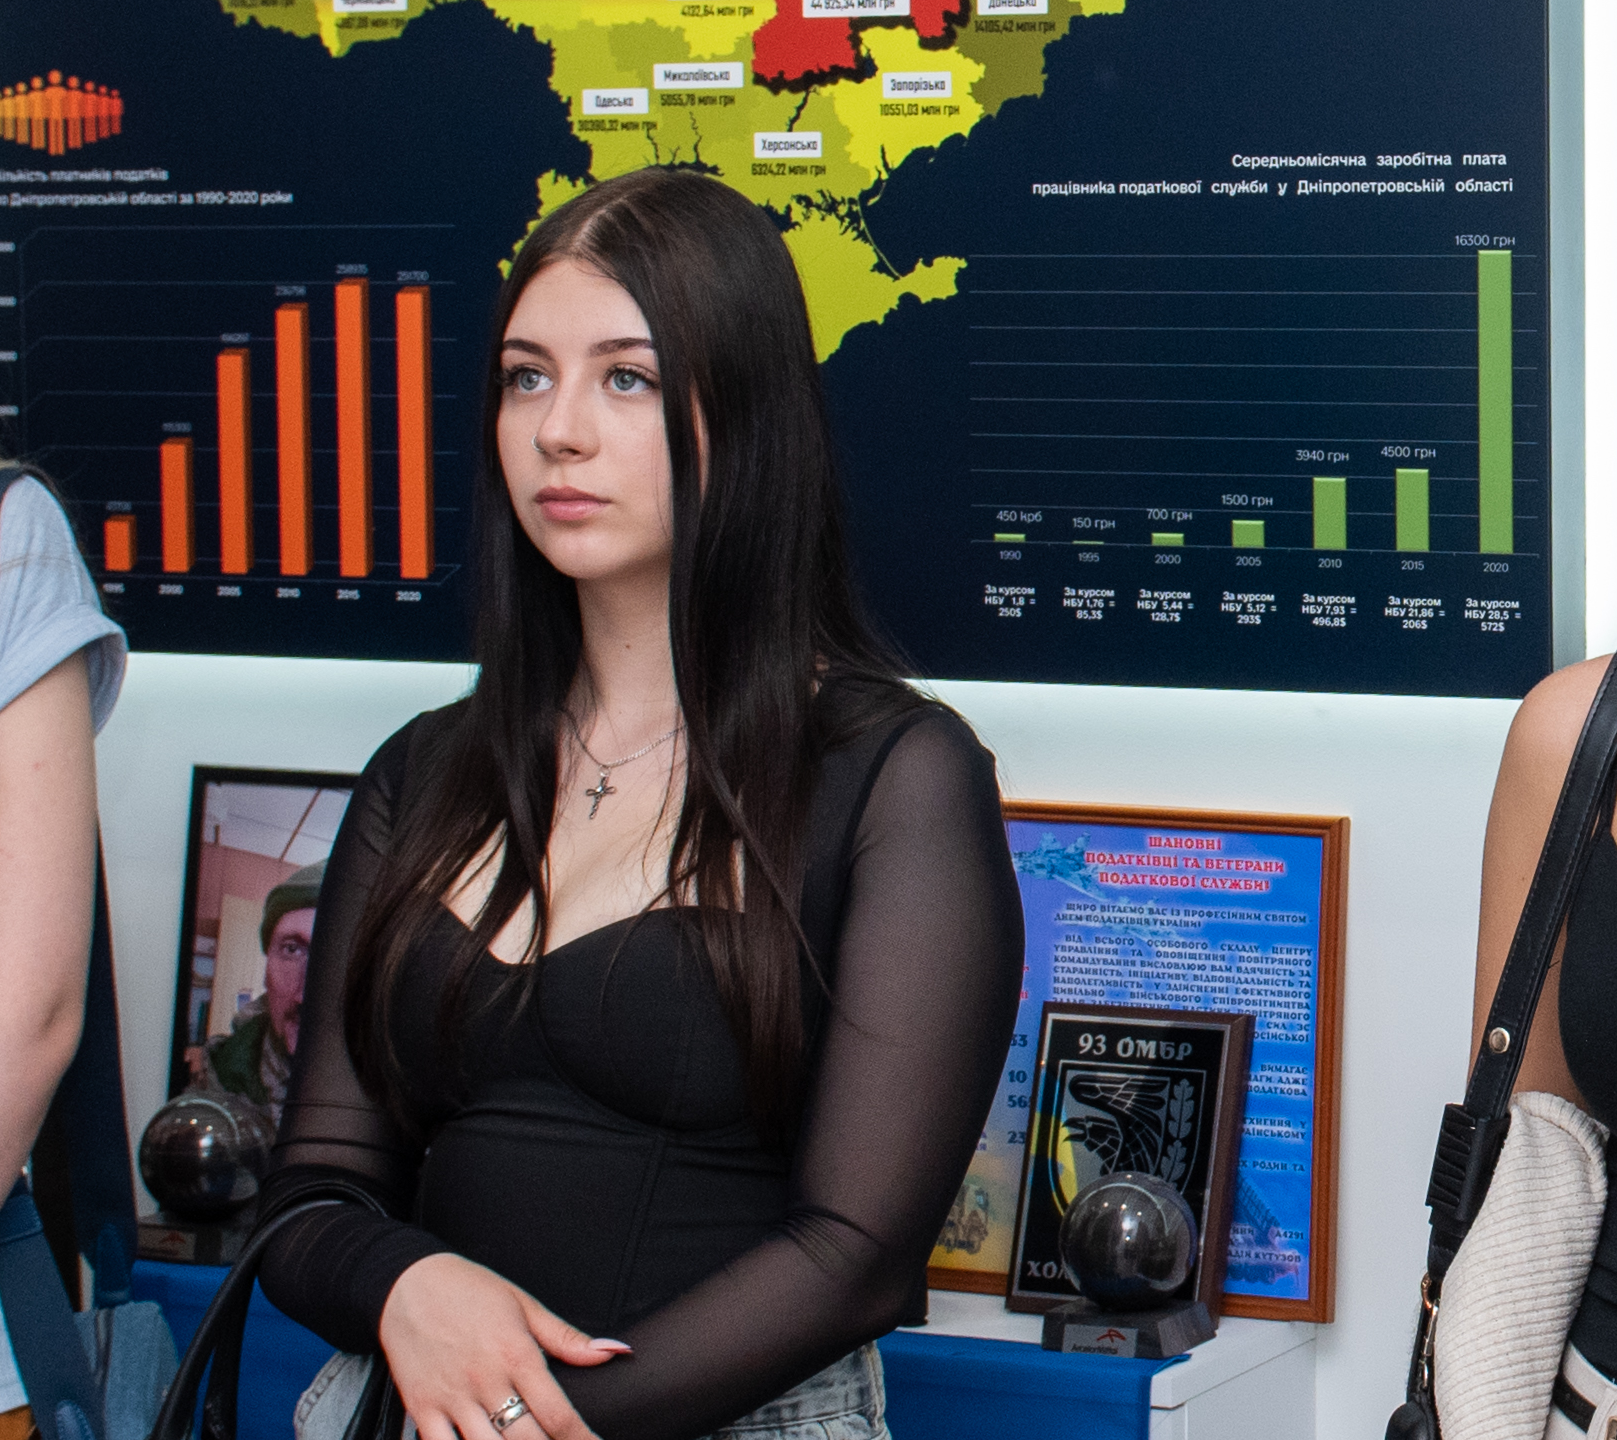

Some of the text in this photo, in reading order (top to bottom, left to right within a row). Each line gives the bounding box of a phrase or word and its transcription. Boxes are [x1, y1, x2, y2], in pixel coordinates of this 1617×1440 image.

[1232, 152, 1507, 169] Середньомісячна заробітна плата
[1033, 178, 1513, 197] працівника податкової служби у Дніпропетровській області
[1455, 234, 1516, 248] 16300 грн
[1296, 449, 1349, 463] 3940 грн
[1381, 446, 1436, 459] 4500 грн
[1222, 494, 1274, 508] 1500 грн
[996, 509, 1017, 522] 450
[1146, 507, 1193, 522] 700 грн
[1072, 517, 1115, 530] 150 грн
[1149, 837, 1221, 850] ШАНОВНІ
[1099, 872, 1195, 888] ПОДАТКОВОЇ
[1085, 852, 1311, 988] ПОДАТКІВЦІ ТА ВЕТЕРАНИ
[1077, 1032, 1107, 1056] 93
